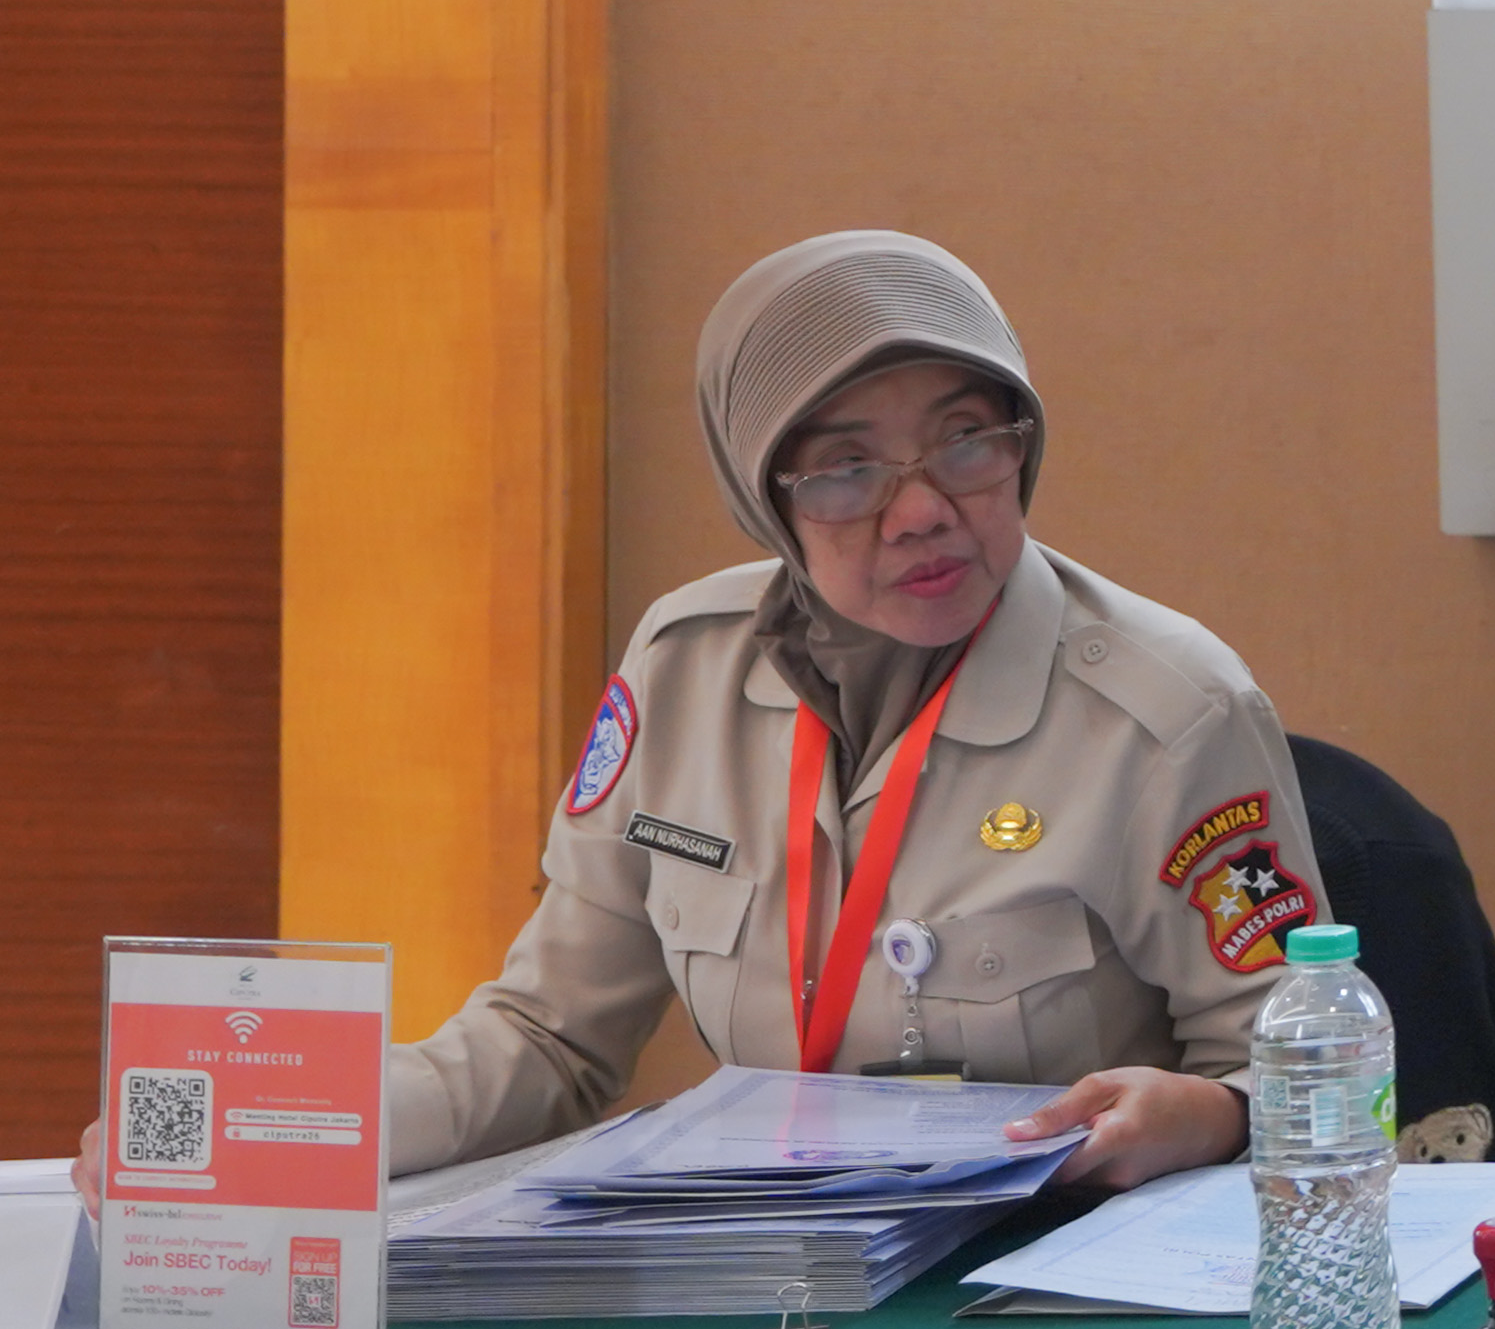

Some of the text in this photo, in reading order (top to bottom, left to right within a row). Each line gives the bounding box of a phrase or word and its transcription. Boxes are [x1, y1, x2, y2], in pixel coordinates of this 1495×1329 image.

[633, 822, 723, 862] AAN NURHASANAH
[1168, 801, 1261, 879] KORLANTAS
[1221, 894, 1305, 959] MABES POLRI
[187, 1050, 303, 1066] STAY CONNECTED
[123, 1250, 272, 1276] Join SBEC Today!
[200, 1287, 225, 1297] OFF
